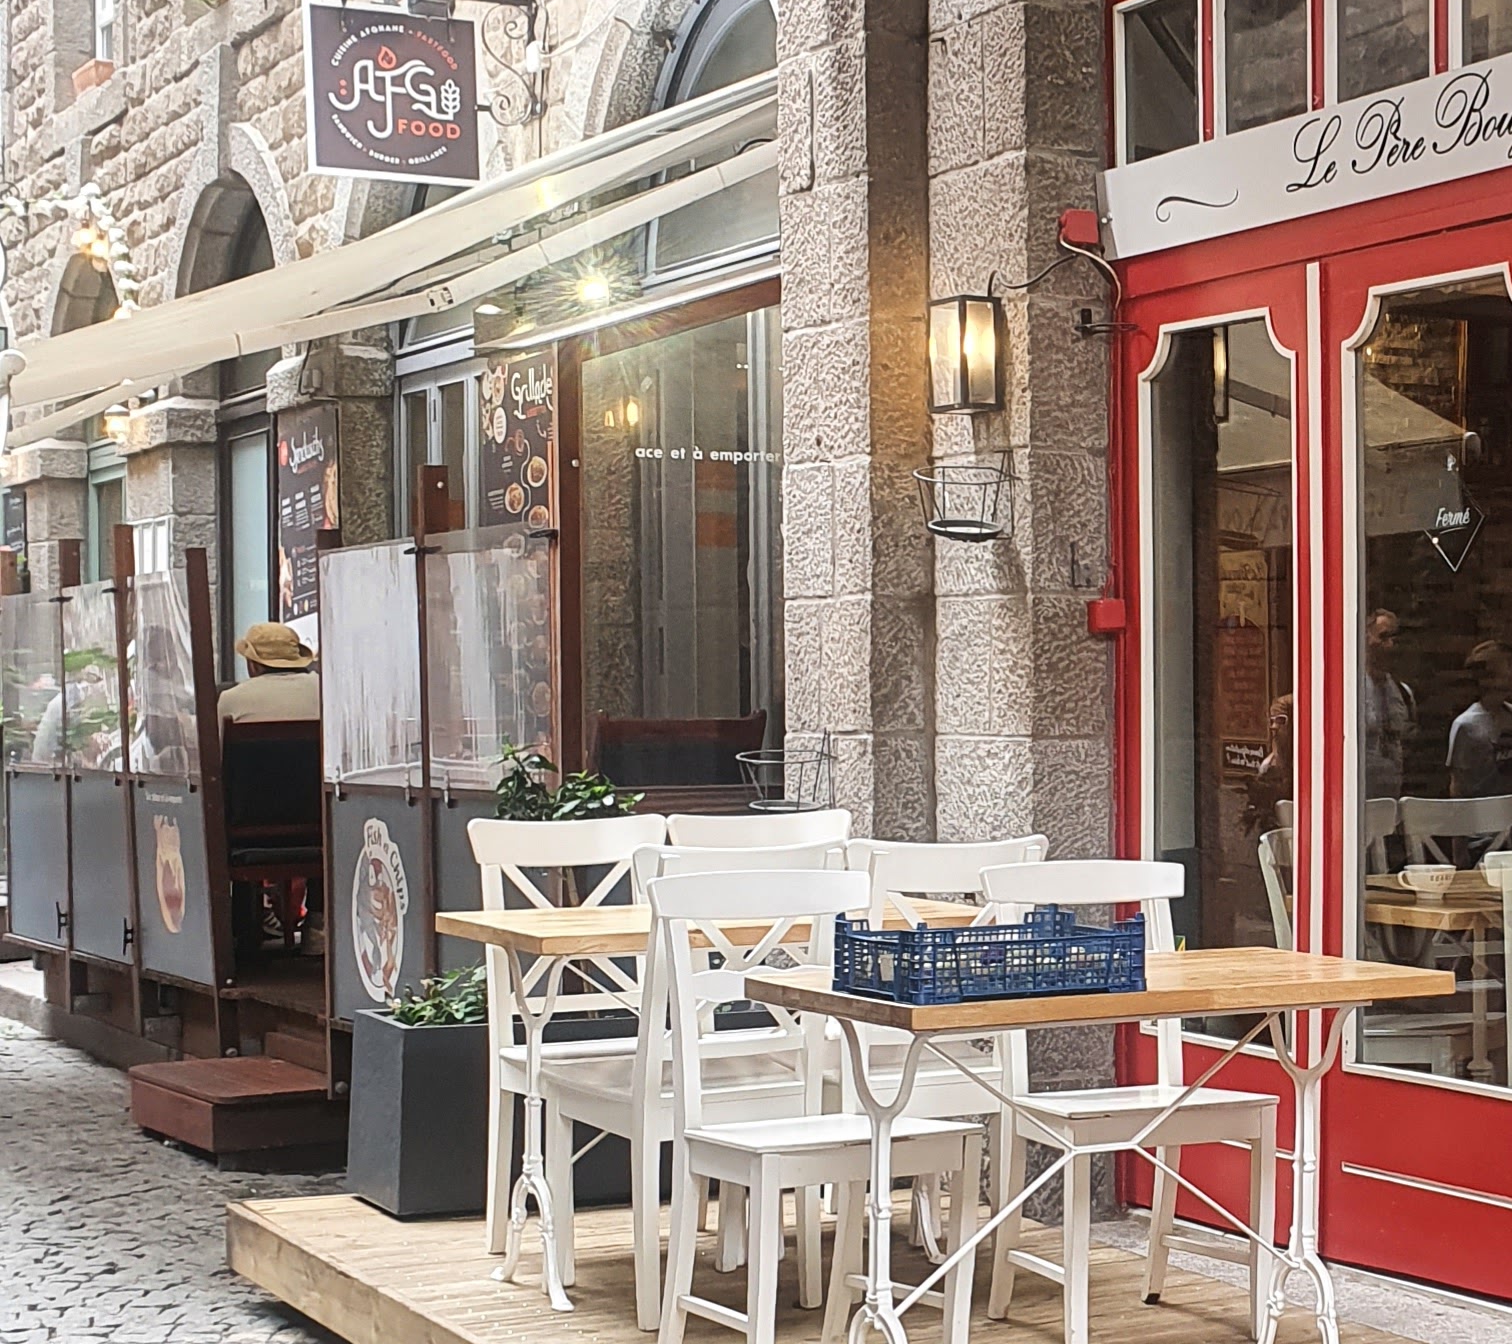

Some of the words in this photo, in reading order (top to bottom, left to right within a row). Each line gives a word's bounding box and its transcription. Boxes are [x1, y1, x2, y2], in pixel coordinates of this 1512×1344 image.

[397, 118, 461, 140] FOOD
[1286, 114, 1342, 193] Le
[1351, 96, 1427, 174] Père
[670, 447, 686, 460] et
[692, 446, 703, 460] à
[709, 450, 781, 465] emporter
[1435, 506, 1471, 528] Fermé
